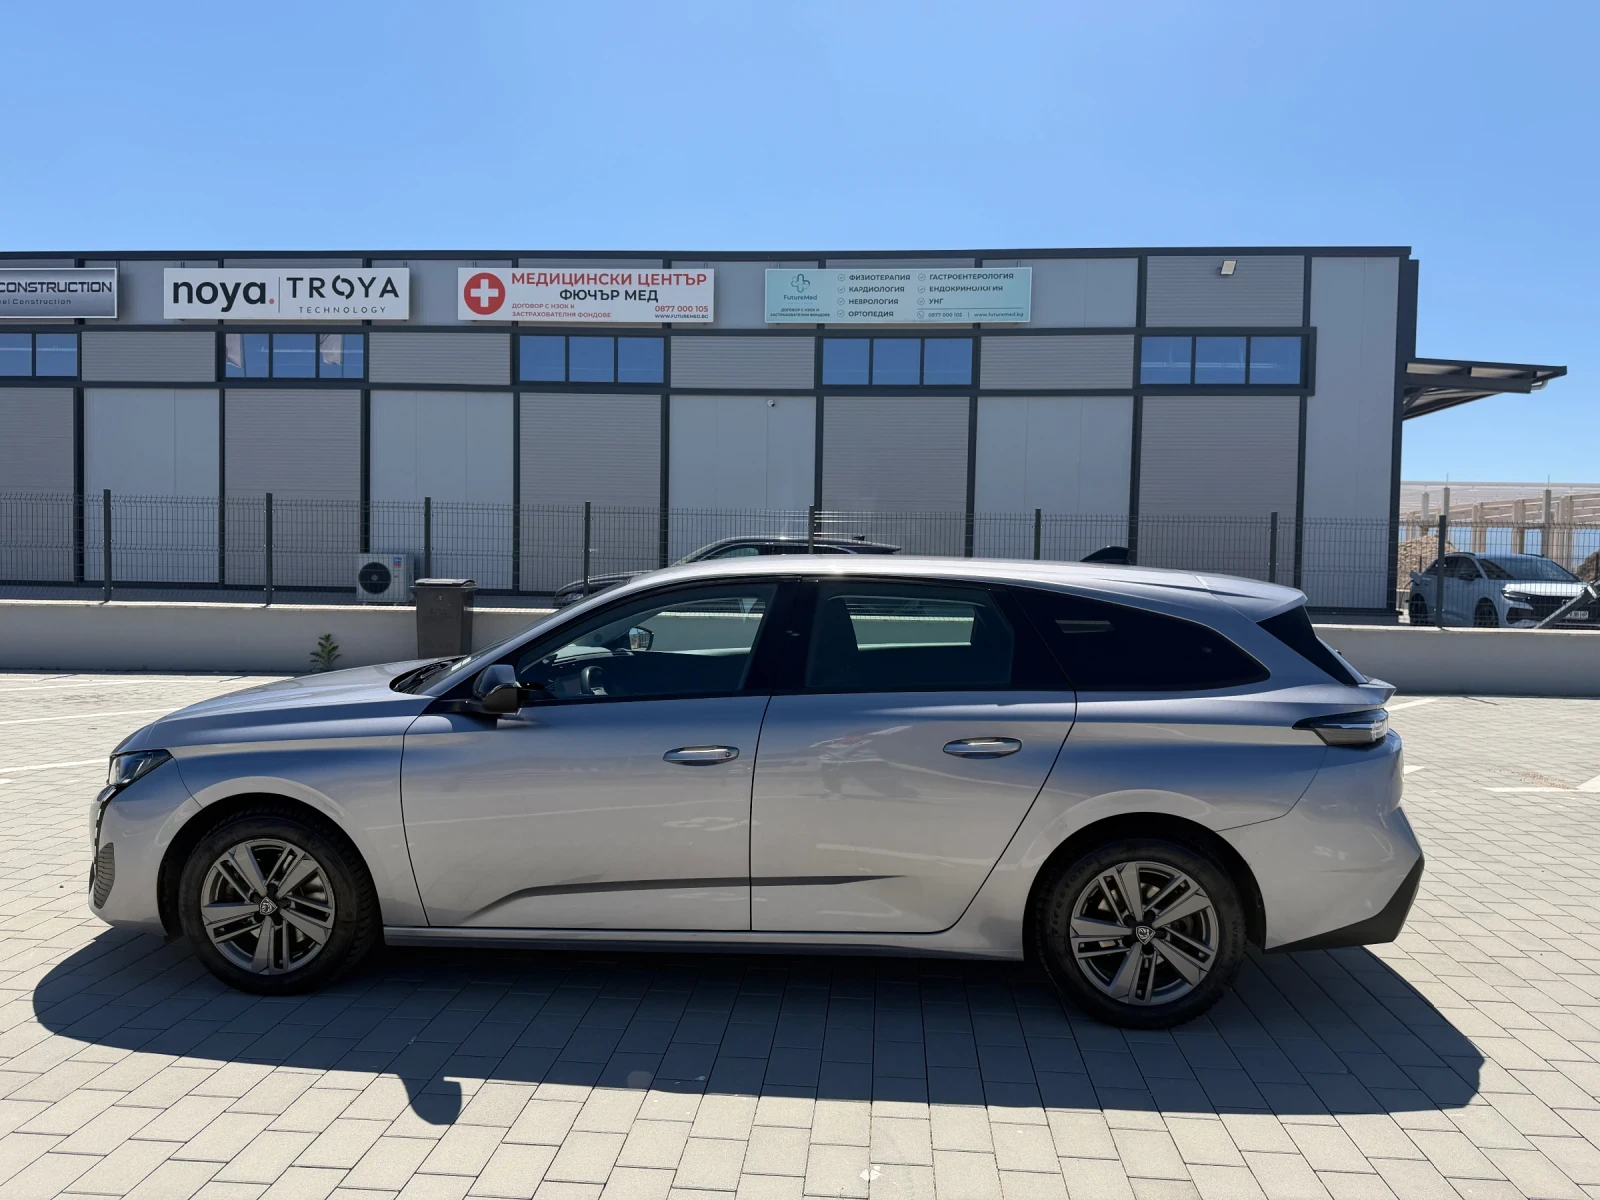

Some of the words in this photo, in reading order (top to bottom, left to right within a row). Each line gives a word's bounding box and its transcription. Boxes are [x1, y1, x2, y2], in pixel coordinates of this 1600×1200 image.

[511, 272, 632, 287] МЕДИЦИНСКИ
[637, 273, 707, 287] ЦЕНТЪР
[0, 281, 113, 293] CONSTRUCTION
[286, 274, 400, 300] TROYA
[929, 285, 1004, 293] ЕНДОКРИНОЛОГИЯ
[559, 288, 620, 301] ФЮЧЪР
[624, 289, 659, 303] МЕД
[298, 306, 387, 314] TECHNOLOGY
[695, 305, 709, 313] 105
